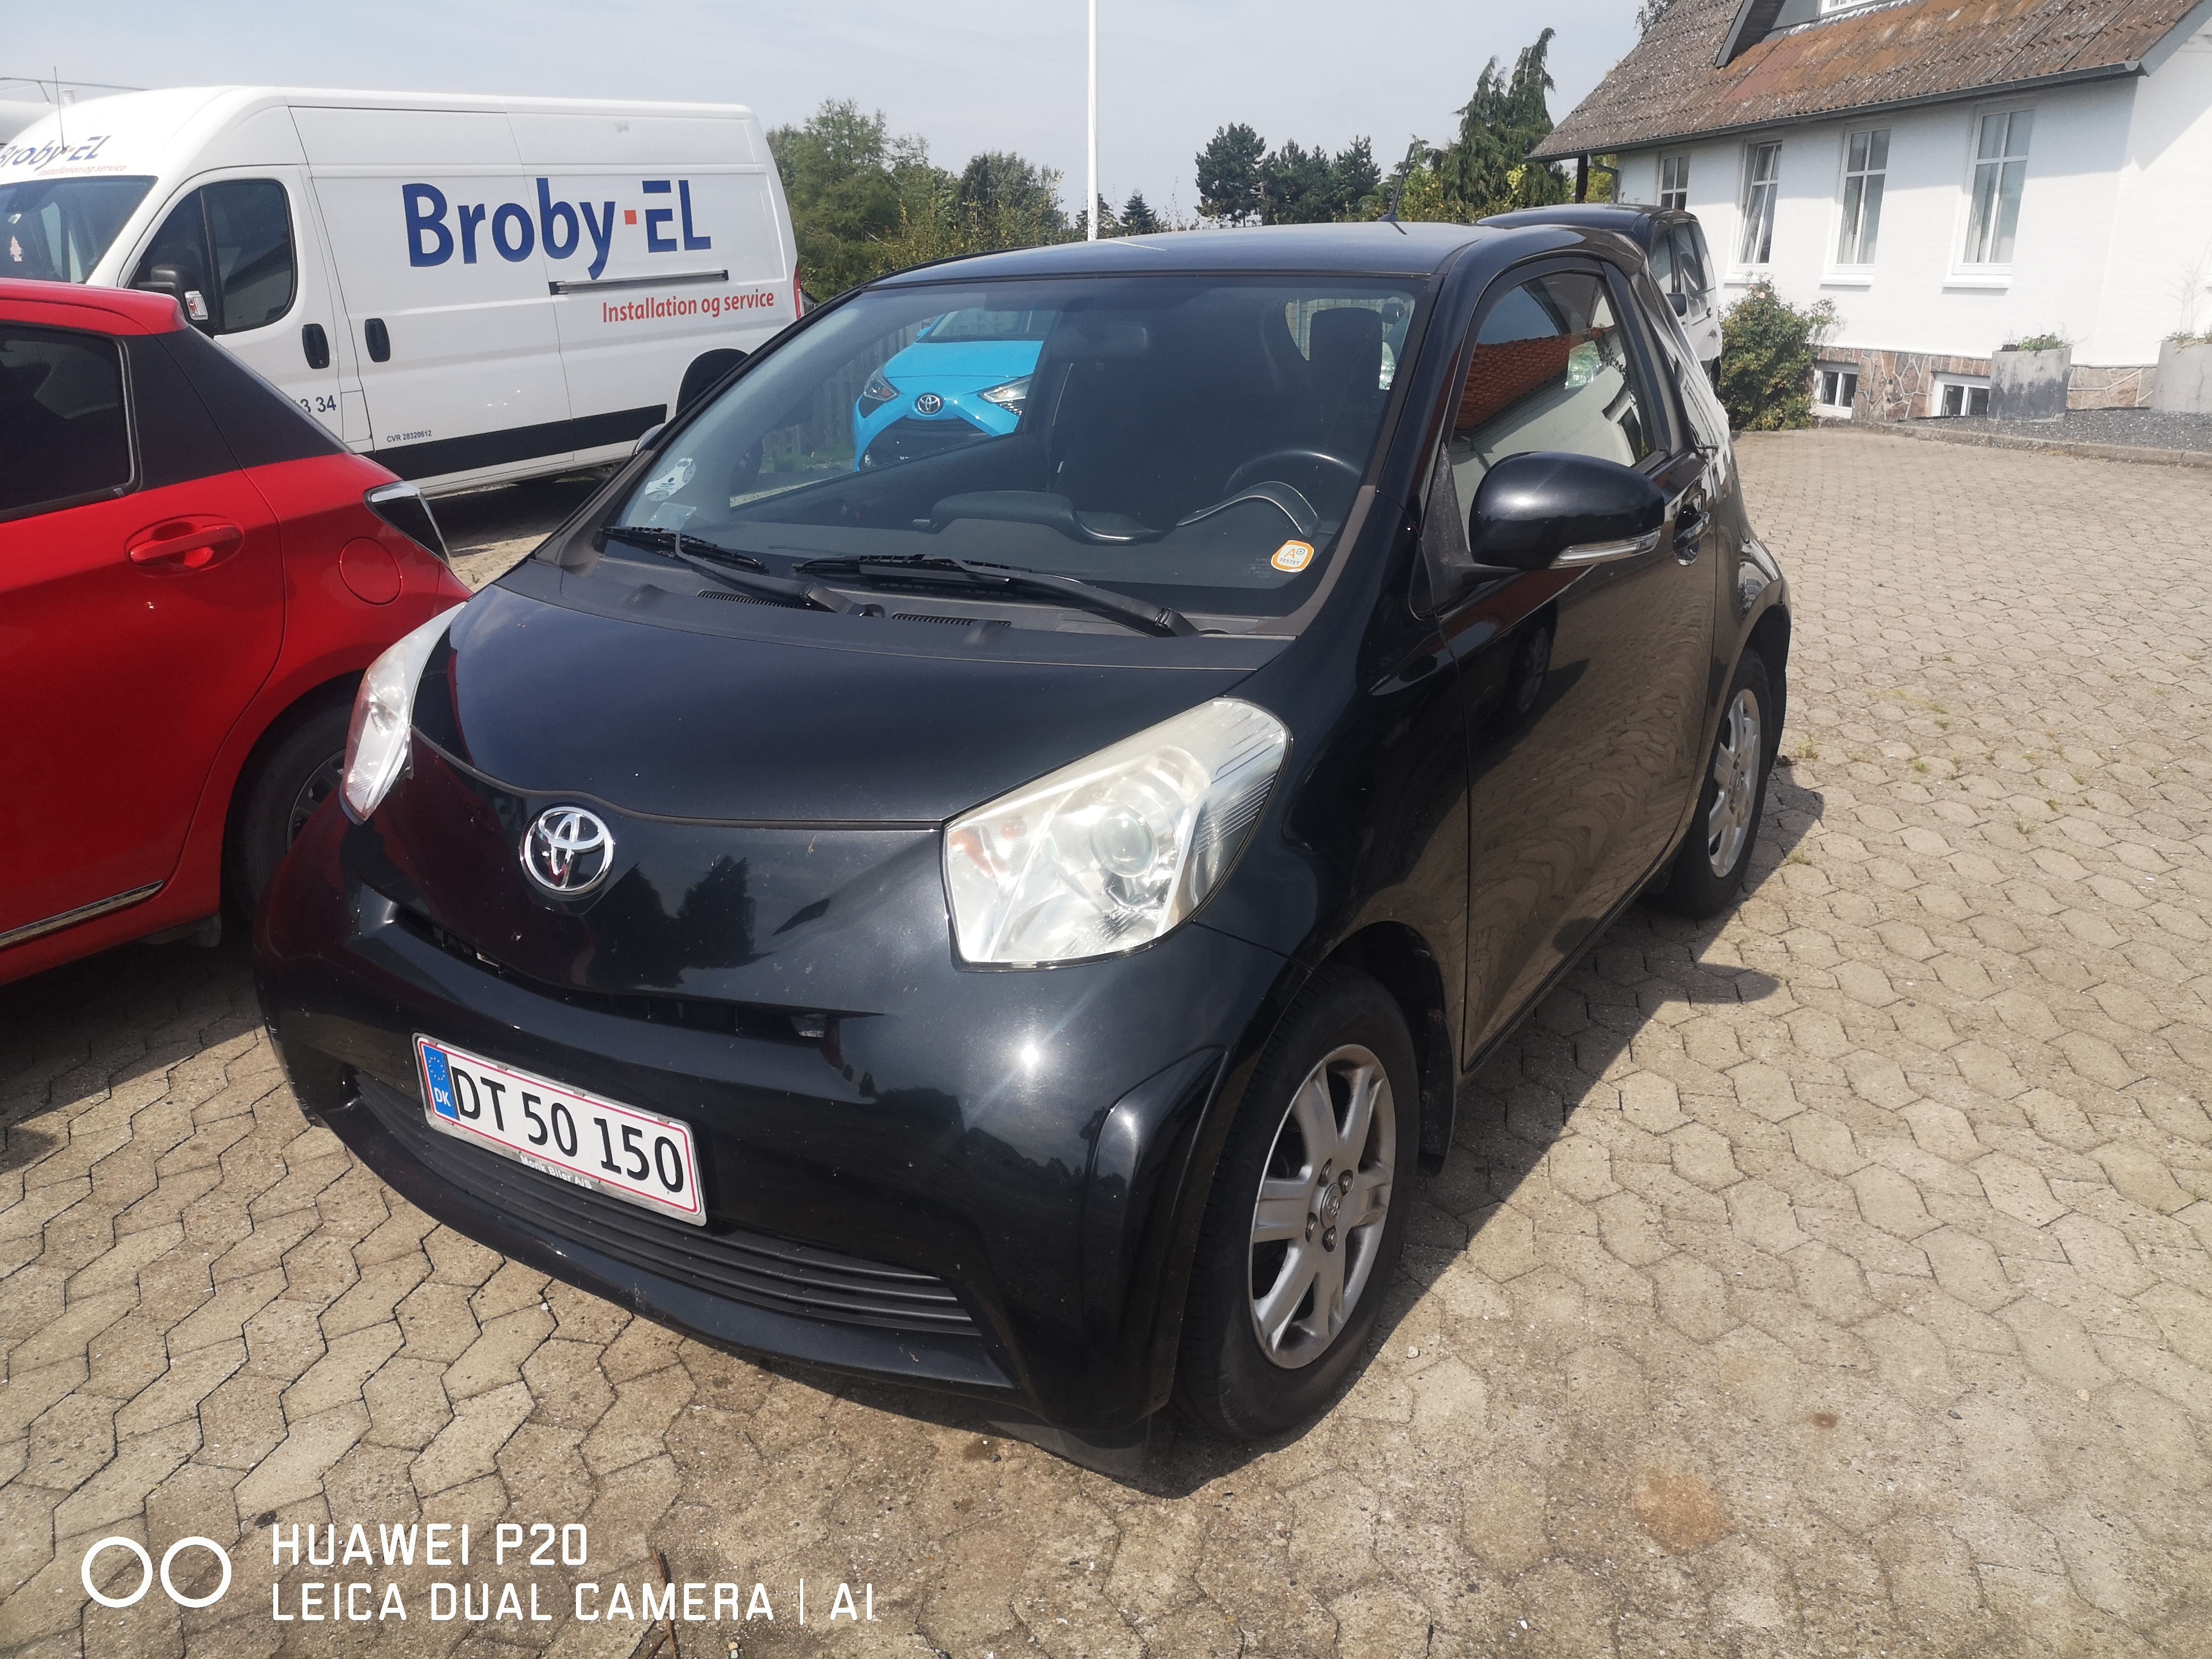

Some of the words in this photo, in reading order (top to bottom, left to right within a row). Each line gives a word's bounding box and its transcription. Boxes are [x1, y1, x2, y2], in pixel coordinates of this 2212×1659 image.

[37, 166, 83, 176] Installation
[95, 163, 127, 172] service
[603, 295, 697, 323] Installation
[701, 297, 720, 318] og
[724, 288, 774, 311] service
[316, 395, 337, 413] 34
[386, 434, 401, 443] CVR
[402, 429, 432, 440] 28320612
[434, 1087, 451, 1107] DK
[450, 1065, 506, 1132] DT
[521, 1091, 578, 1157] 50
[593, 1117, 684, 1193] 150
[520, 1154, 547, 1173] Monk
[574, 1176, 592, 1189] A/S
